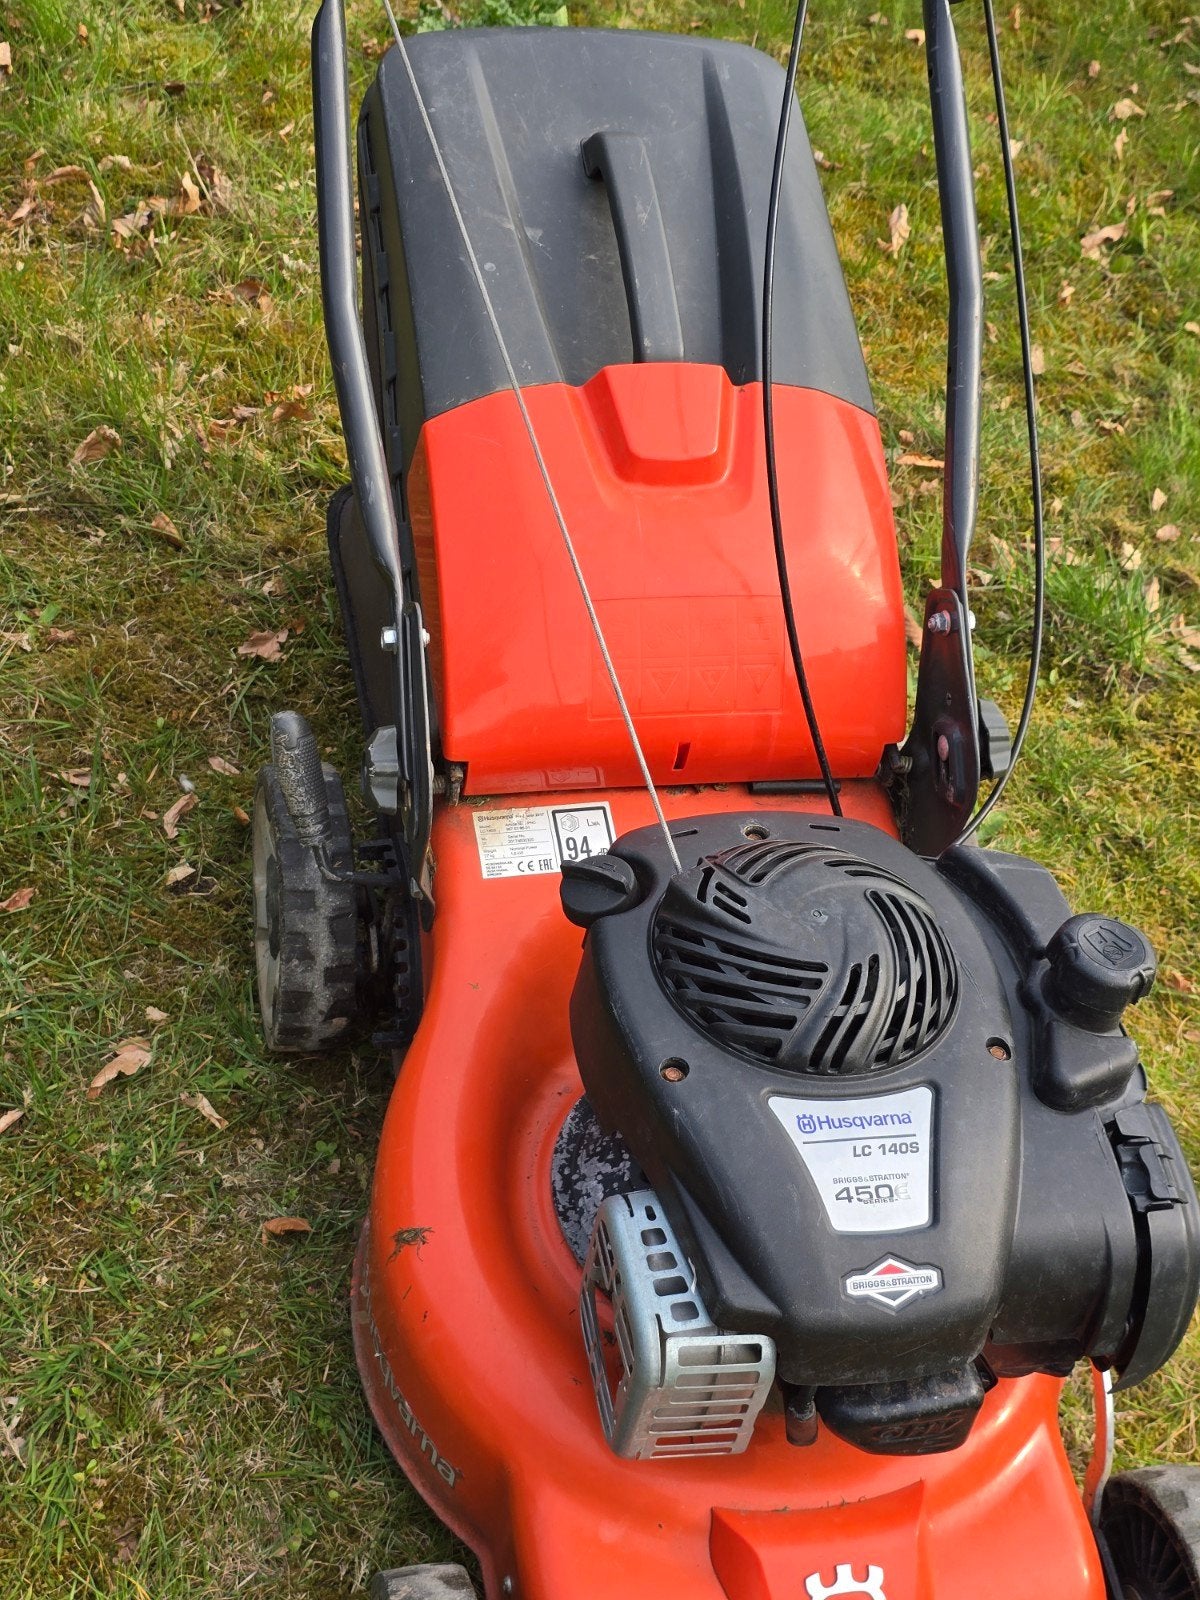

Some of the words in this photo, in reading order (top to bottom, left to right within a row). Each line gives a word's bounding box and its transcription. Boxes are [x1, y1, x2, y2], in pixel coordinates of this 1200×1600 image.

[565, 835, 592, 861] 94
[816, 1111, 913, 1130] Husqvarna
[853, 1144, 872, 1158] LC
[878, 1141, 920, 1156] 140S
[852, 1275, 933, 1290] BRIGGS&STRATTON
